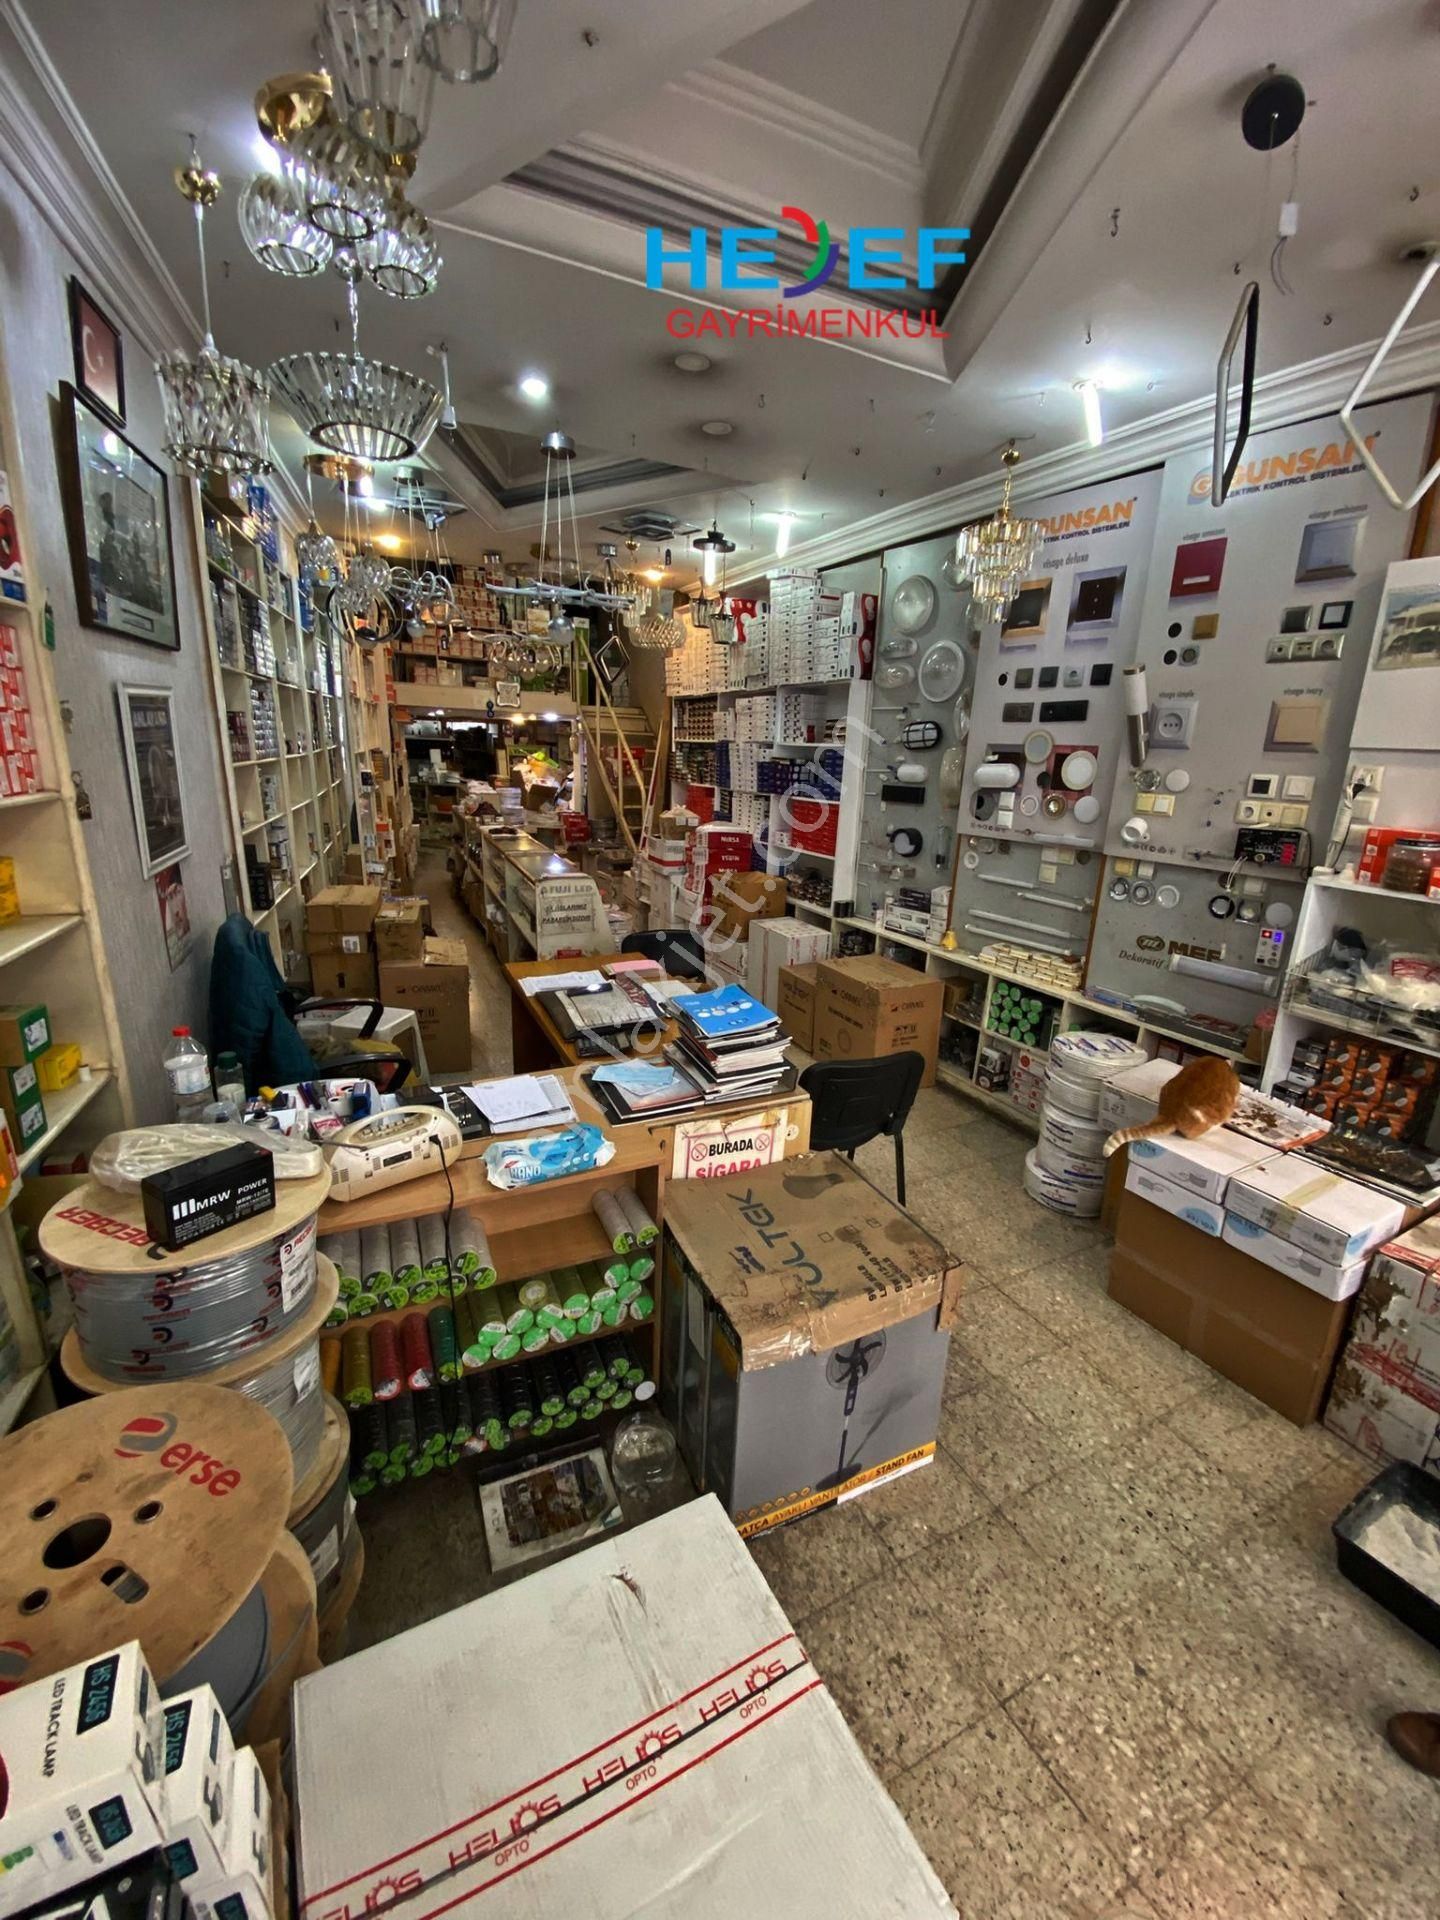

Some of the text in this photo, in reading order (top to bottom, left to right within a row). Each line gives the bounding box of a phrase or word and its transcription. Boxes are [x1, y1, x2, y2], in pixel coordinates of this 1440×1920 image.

[1118, 949, 1164, 969] Dekoratif
[708, 1138, 754, 1157] BURADA
[237, 1177, 268, 1194] POWER
[196, 1189, 231, 1212] MRW
[160, 1440, 242, 1497] erse
[875, 1457, 905, 1477] STAND
[906, 1448, 925, 1465] FAN
[699, 1659, 788, 1723] HELIOS
[738, 1695, 768, 1720] OPTO
[41, 1677, 67, 1778] LED TRACK LAMP
[582, 1723, 684, 1792] HELIOS
[625, 1765, 657, 1791] OPTO
[448, 1794, 563, 1870] HELIOS
[494, 1839, 530, 1867] OPTO
